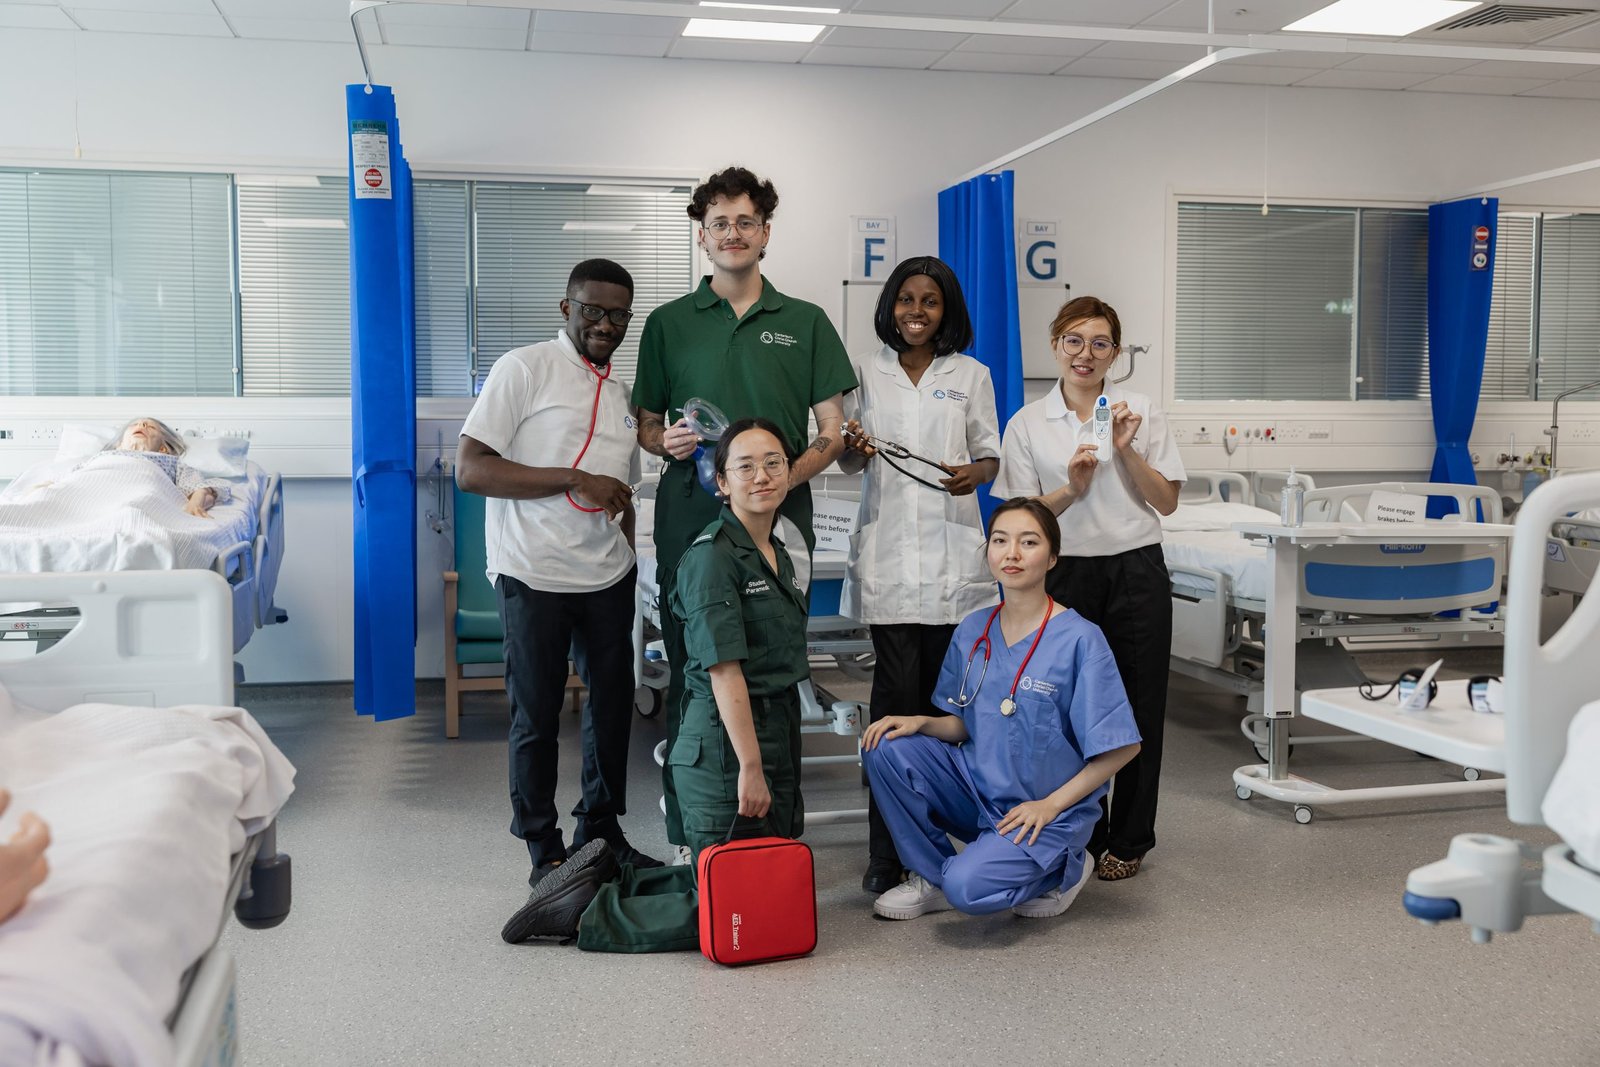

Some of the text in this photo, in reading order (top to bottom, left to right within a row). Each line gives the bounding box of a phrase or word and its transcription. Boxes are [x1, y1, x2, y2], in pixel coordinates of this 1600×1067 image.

[866, 221, 880, 229] BAY
[864, 238, 885, 277] F
[1026, 240, 1057, 280] G
[1377, 504, 1416, 516] Please engage
[813, 512, 851, 523] ease engage
[812, 522, 850, 533] akes before
[748, 580, 766, 588] Student
[1034, 679, 1056, 688] Canterbury
[1032, 687, 1052, 696] University
